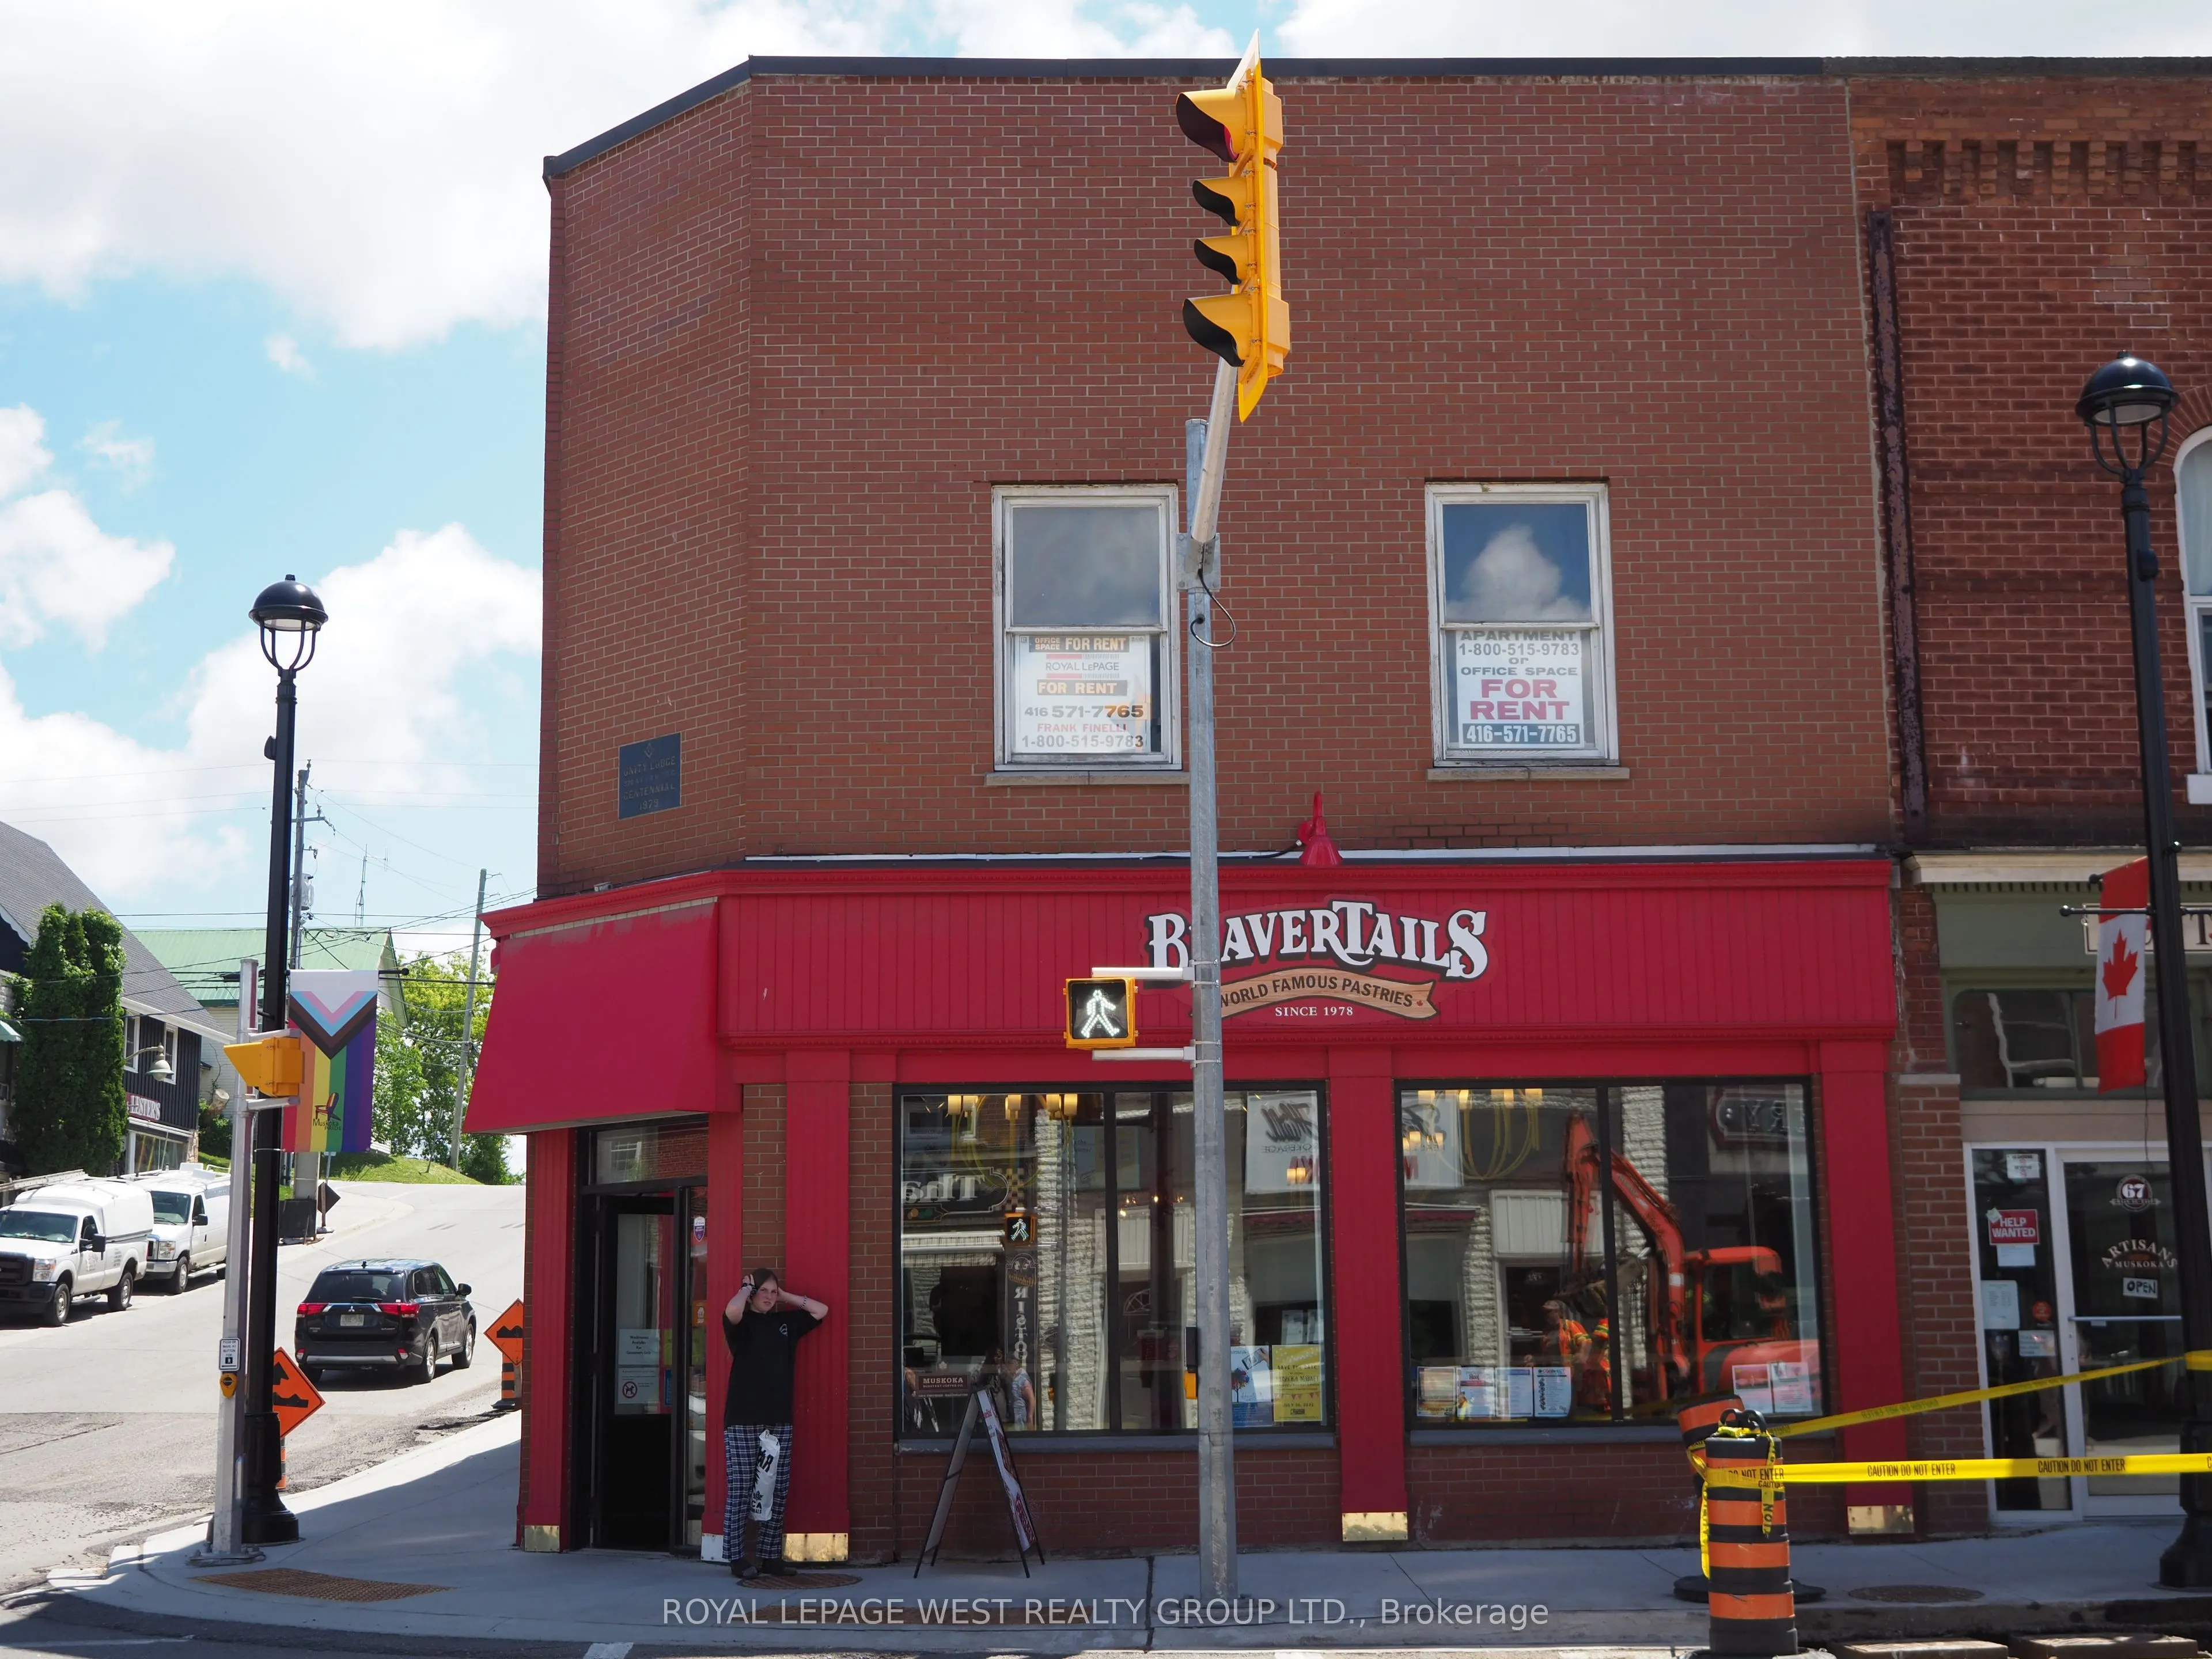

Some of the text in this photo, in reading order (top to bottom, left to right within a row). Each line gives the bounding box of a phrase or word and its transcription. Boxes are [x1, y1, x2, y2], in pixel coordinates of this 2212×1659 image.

[1460, 630, 1576, 641] APARTMENT
[1065, 637, 1090, 650] FOR
[1093, 637, 1126, 650] RENT
[1459, 643, 1579, 656] 1-800-515-9783
[1046, 662, 1080, 671] ROYAL
[1509, 657, 1529, 665] or
[1461, 666, 1578, 676] OFFICE SPACE
[1038, 682, 1118, 694] FOR RENT
[1480, 679, 1558, 698] FOR
[1024, 705, 1144, 718] 416 571-7765
[1469, 700, 1570, 720] RENT
[1037, 724, 1128, 733] FRANK FINELLI
[1466, 725, 1577, 743] 416-571-7765
[1022, 735, 1144, 748] 1-800-515-9783
[1272, 975, 1338, 994] FAMOUS
[1342, 979, 1414, 1007] PASTRIES
[1275, 1006, 1354, 1017] SINCE 1978
[129, 1095, 161, 1120] LESTER'S
[313, 1119, 339, 1127] Muskoka
[2122, 1183, 2146, 1198] 67
[2000, 1217, 2027, 1227] HELP
[1992, 1228, 2036, 1238] WANTED
[2101, 1238, 2178, 1268] ARTISANS
[2127, 1281, 2156, 1294] OPEN
[1868, 1463, 1956, 1477] CAUTION DO NOT ENTER
[2038, 1458, 2126, 1474] CAUTION DO NOT ENTER
[1760, 1468, 1784, 1480] ENTER
